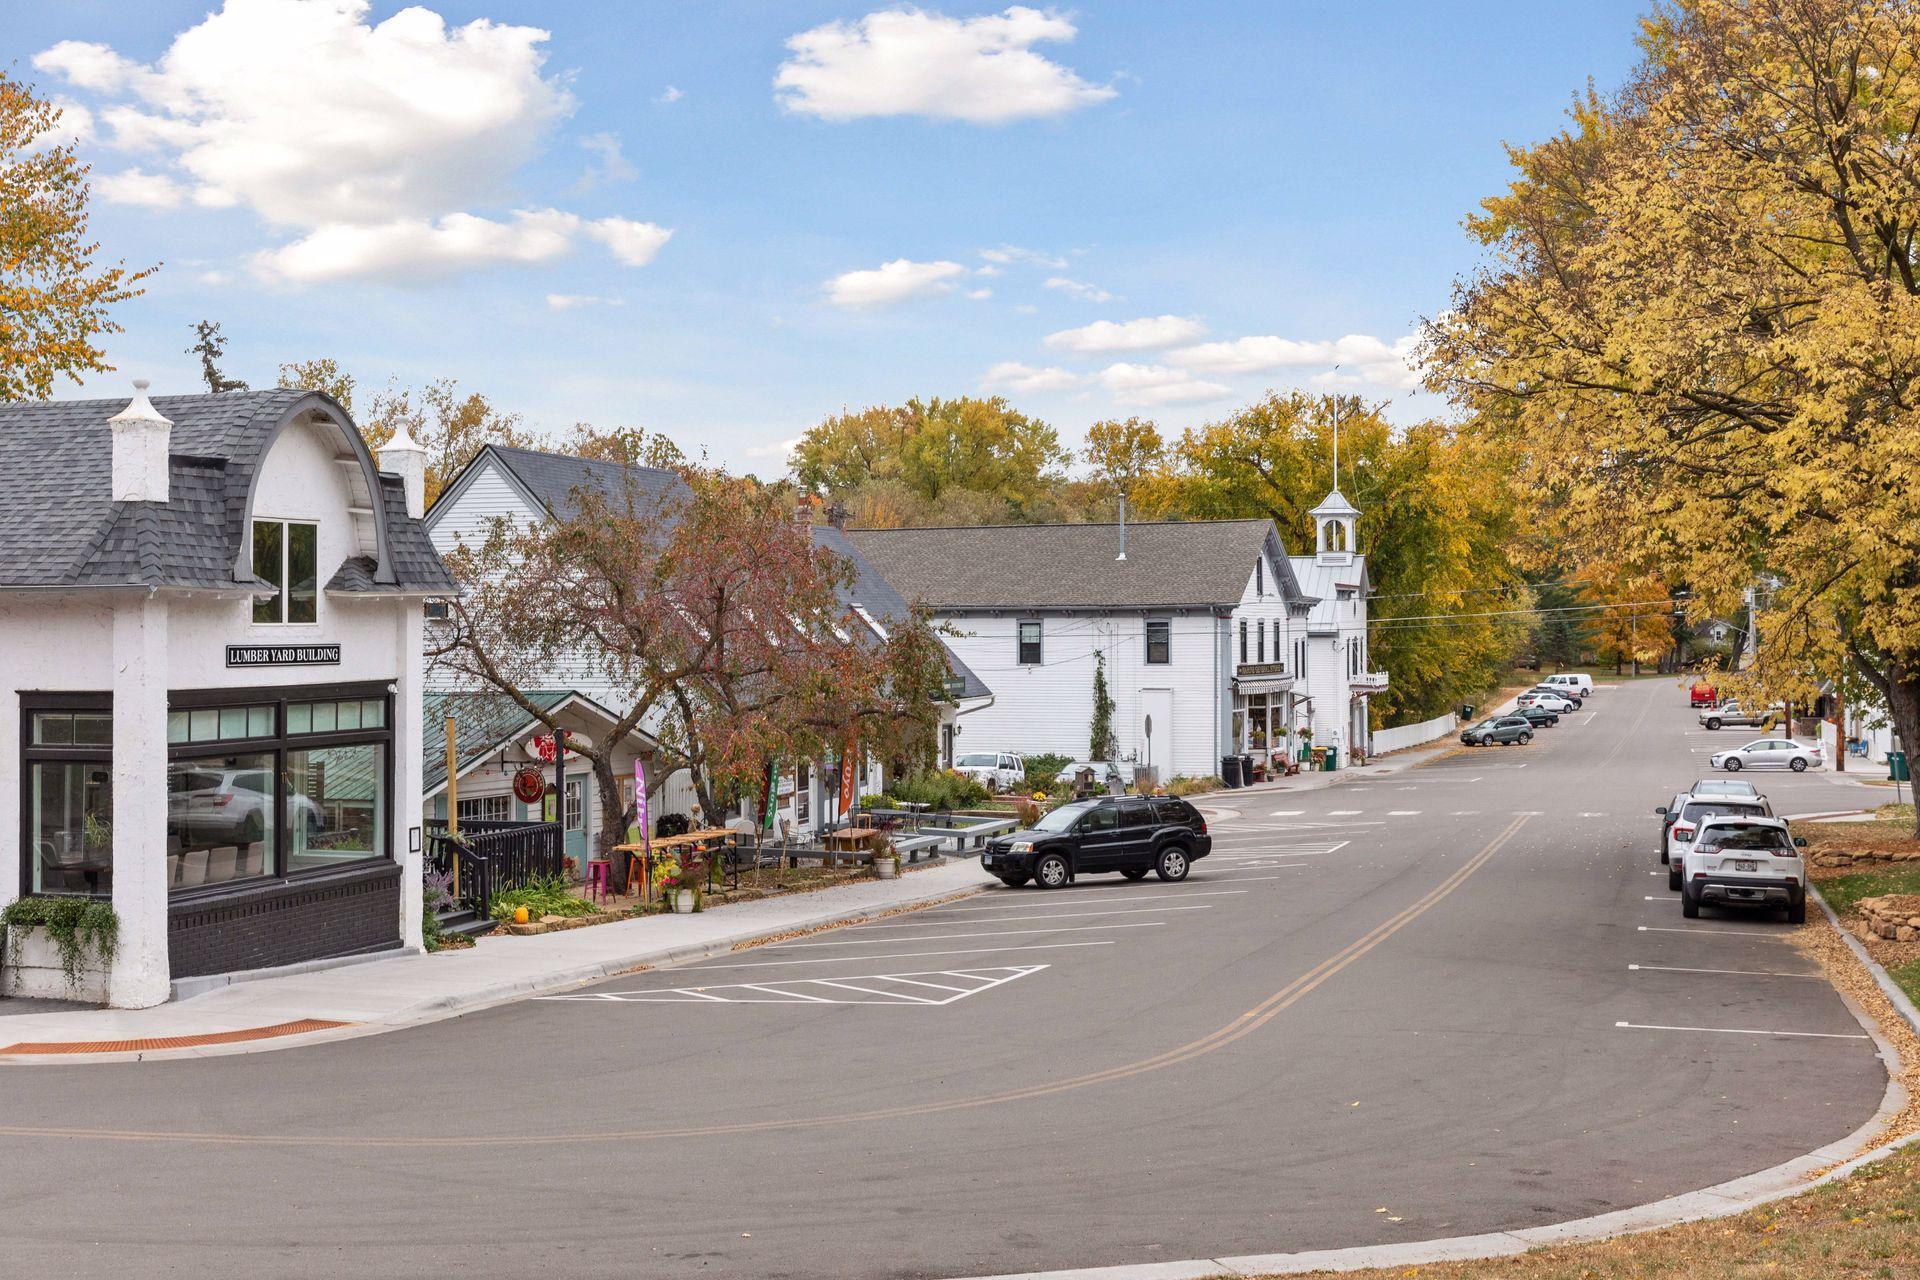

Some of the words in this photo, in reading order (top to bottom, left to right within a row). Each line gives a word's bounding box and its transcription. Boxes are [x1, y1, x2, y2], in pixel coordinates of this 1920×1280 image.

[230, 649, 269, 663] LUMBER
[271, 648, 295, 662] YARD
[296, 647, 338, 661] BUILDING
